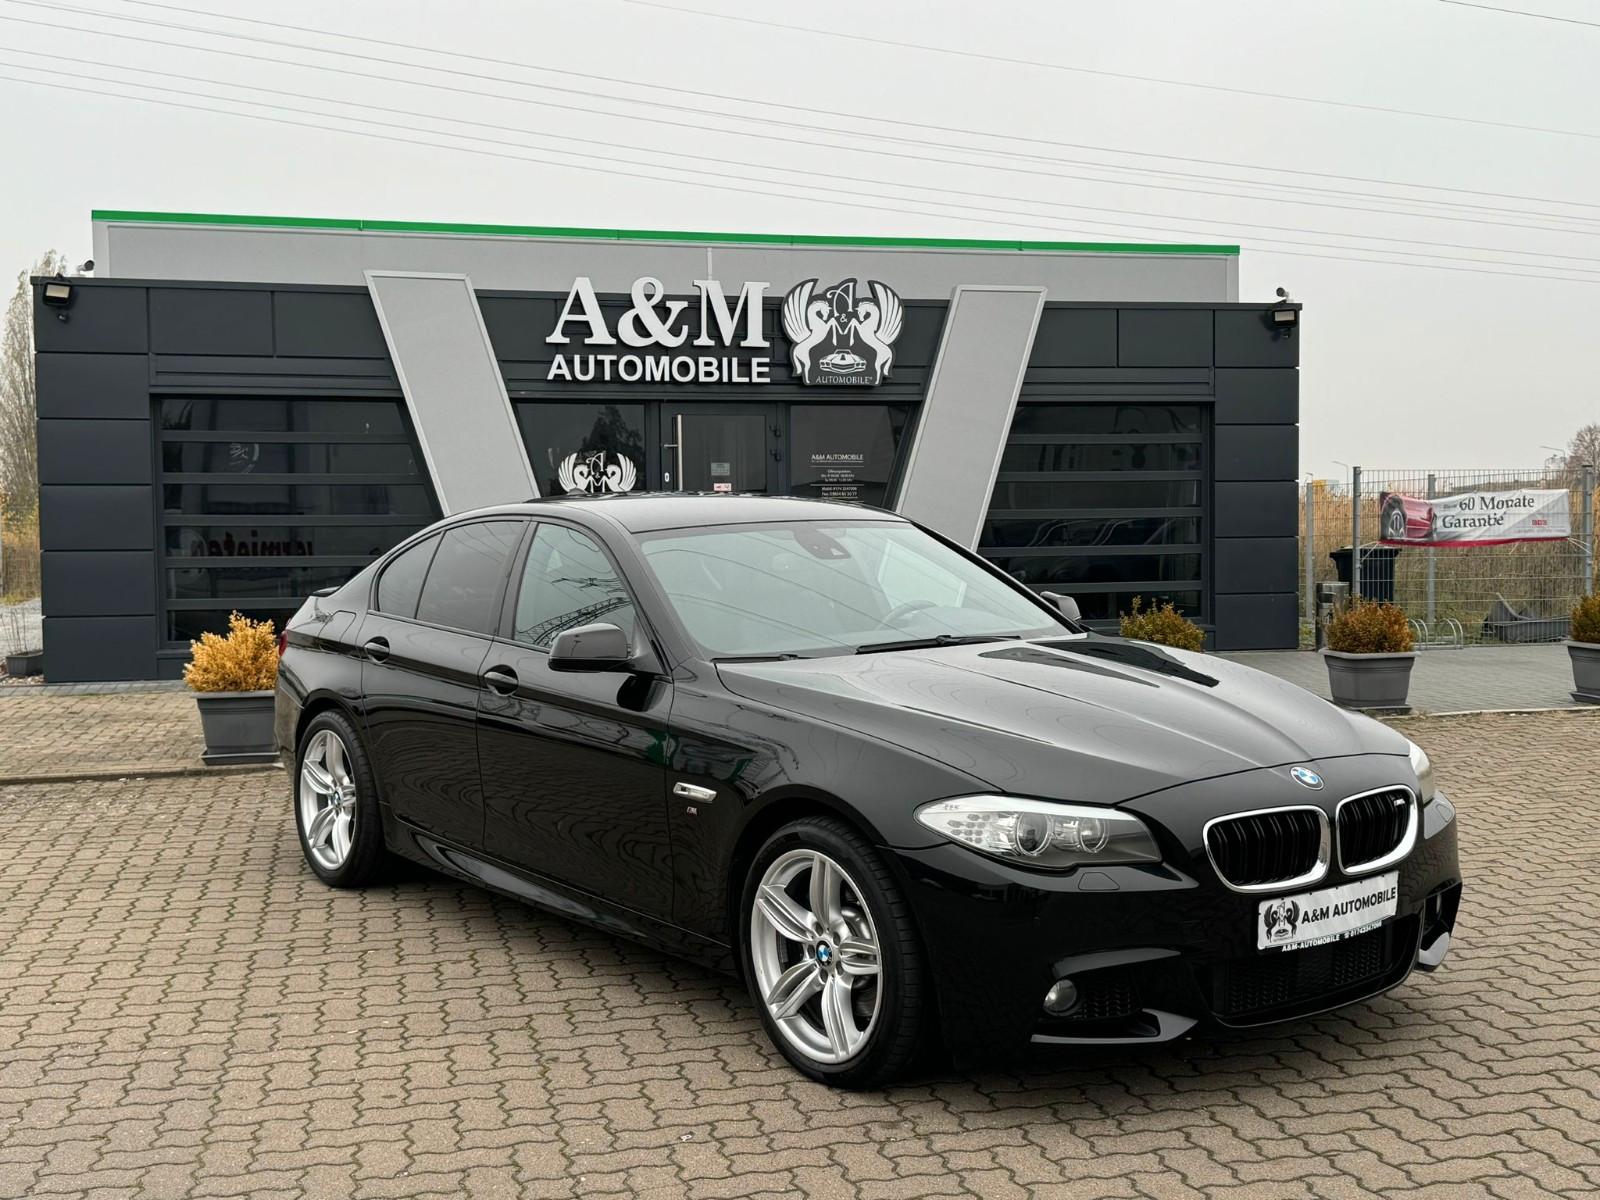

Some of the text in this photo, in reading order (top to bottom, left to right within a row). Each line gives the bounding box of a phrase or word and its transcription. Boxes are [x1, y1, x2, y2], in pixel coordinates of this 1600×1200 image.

[545, 276, 771, 348] A&M
[546, 354, 771, 383] AUTOMOBILE
[1458, 497, 1475, 511] 60
[1479, 494, 1535, 511] Monate
[1301, 886, 1396, 925] A&M AUTOMOBILE
